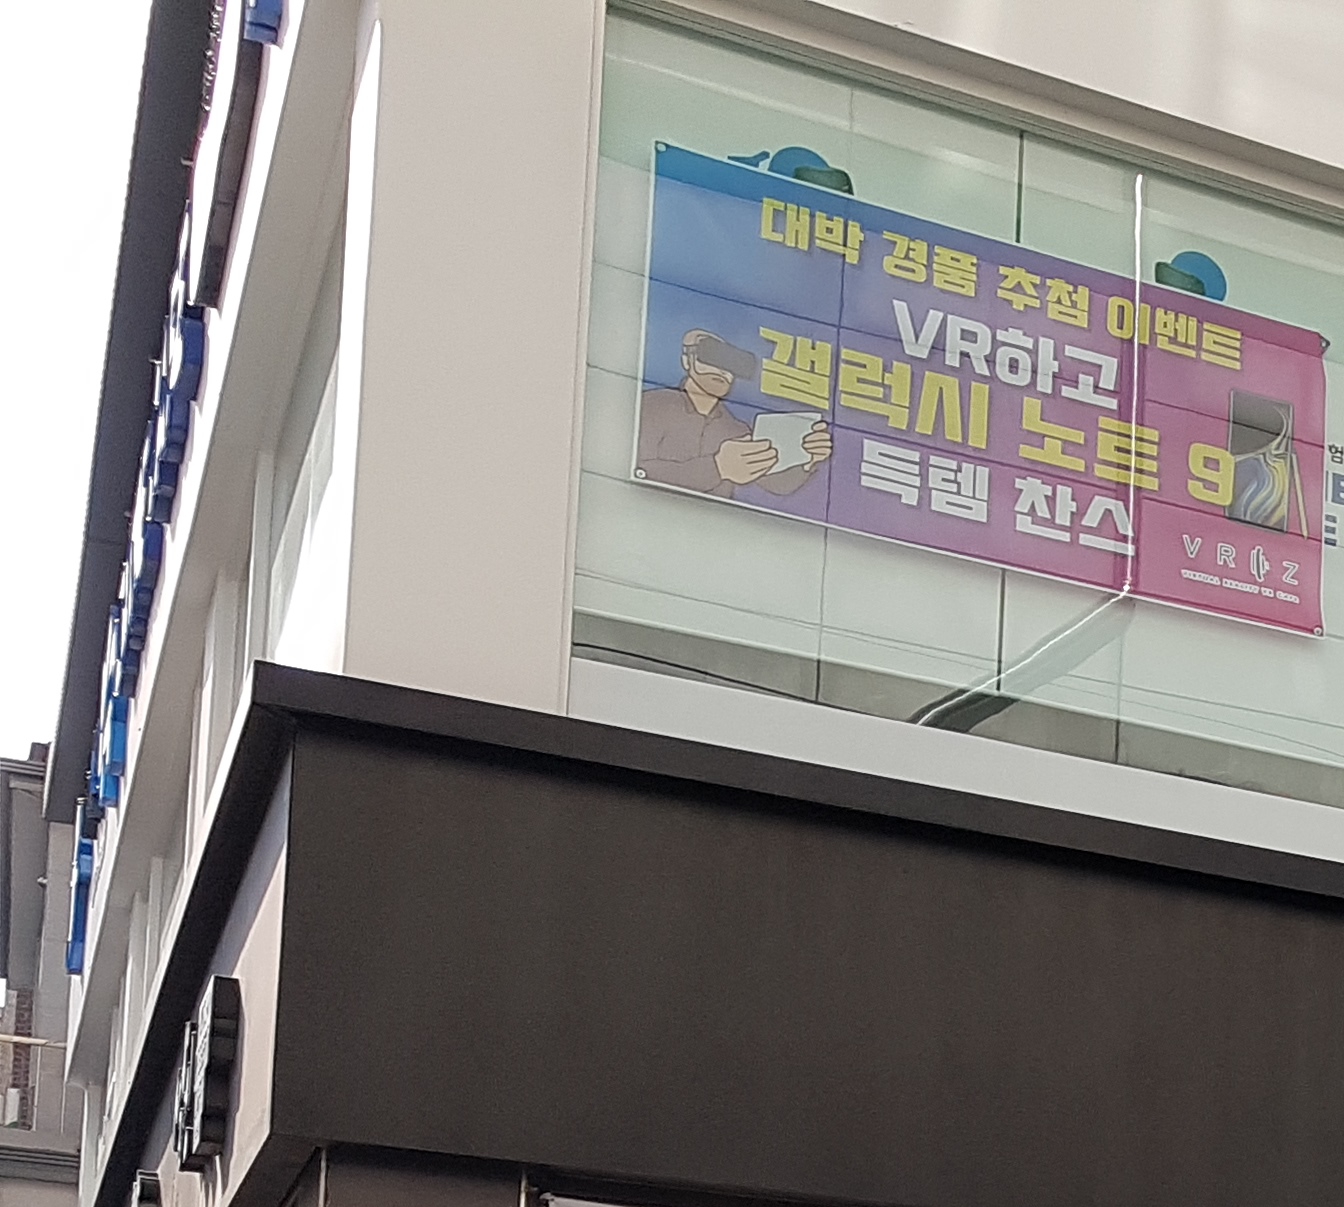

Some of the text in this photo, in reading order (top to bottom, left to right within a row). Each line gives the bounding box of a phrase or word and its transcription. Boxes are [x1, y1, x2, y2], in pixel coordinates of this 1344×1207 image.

[759, 196, 1243, 370] 대박 경품 추첨 이벤트
[893, 300, 1120, 410] VR하고
[756, 327, 1235, 506] 갤럭시 노트 9
[859, 438, 1135, 555] 득템 찬스
